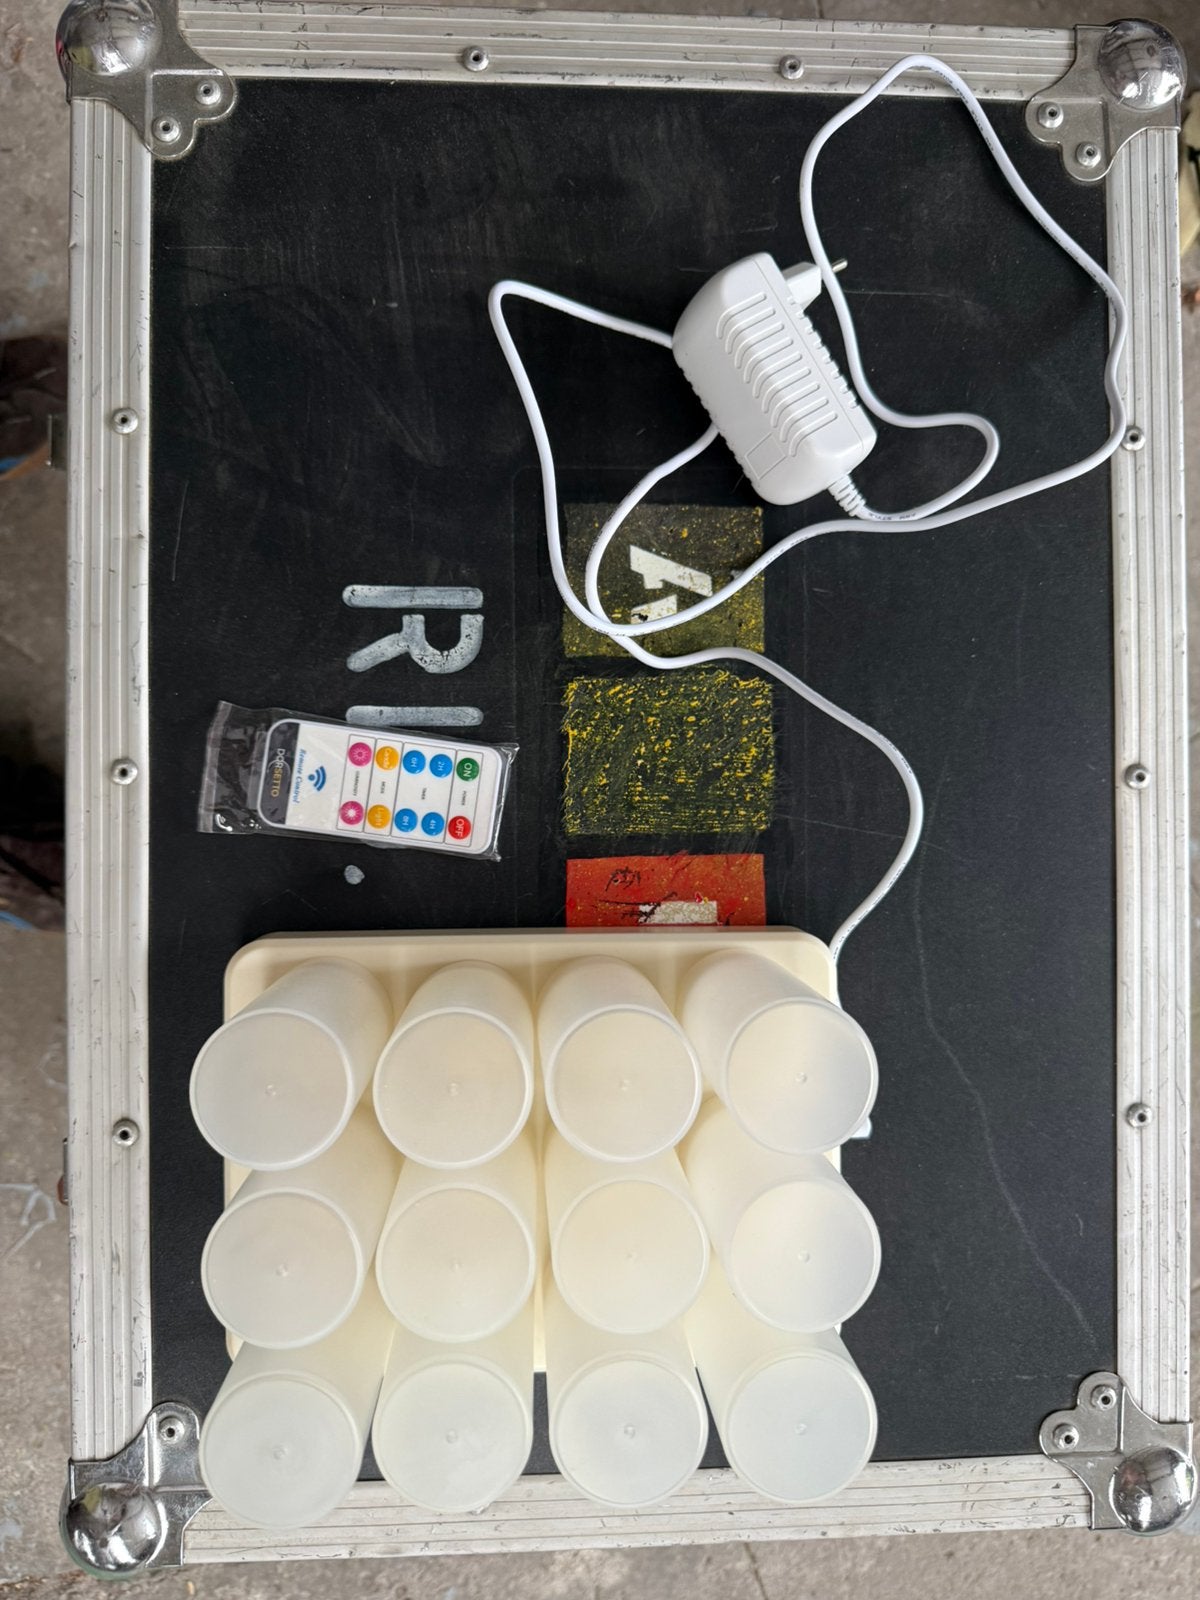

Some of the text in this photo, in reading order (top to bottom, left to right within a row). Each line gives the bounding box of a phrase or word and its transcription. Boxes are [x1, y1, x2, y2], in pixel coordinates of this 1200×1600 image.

[381, 749, 393, 769] Candle
[270, 748, 286, 798] DORSETTO
[292, 748, 307, 804] Remote Control
[463, 762, 473, 778] ON
[429, 761, 445, 829] 2H 4H
[374, 807, 385, 826] Light
[454, 818, 465, 837] OFF
